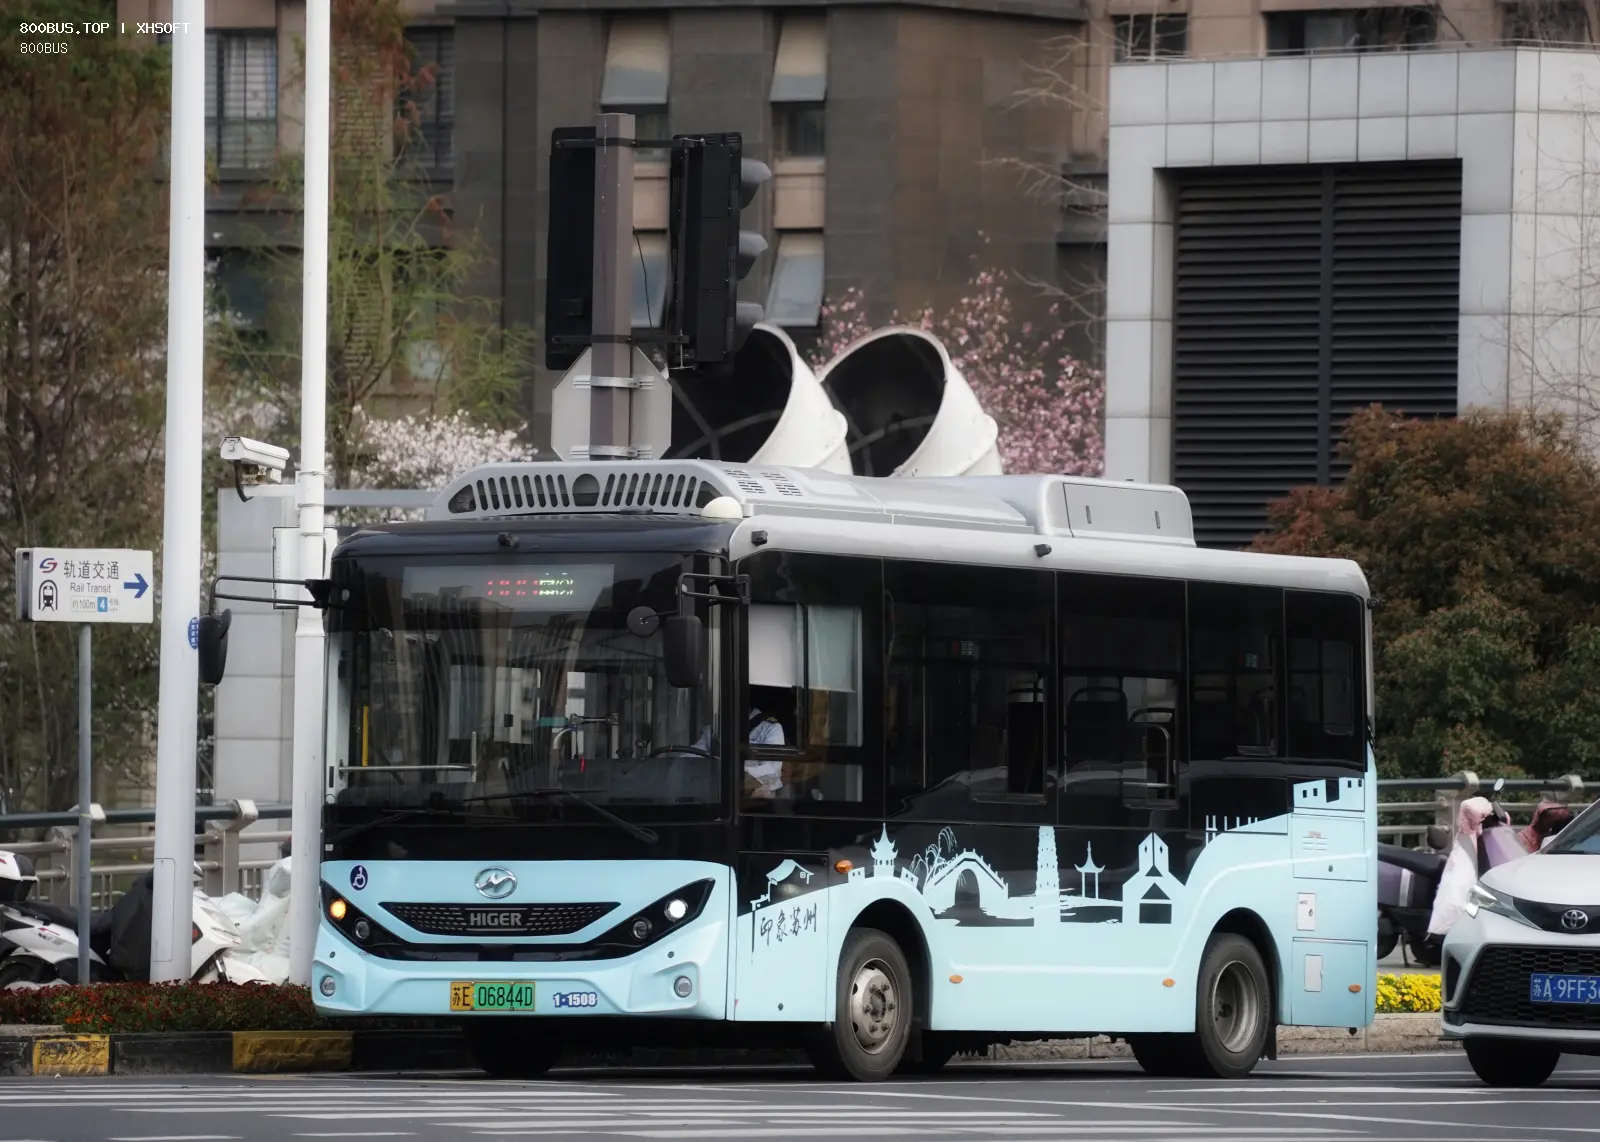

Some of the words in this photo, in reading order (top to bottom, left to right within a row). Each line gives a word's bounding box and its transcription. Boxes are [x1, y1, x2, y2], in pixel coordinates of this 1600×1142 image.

[63, 560, 119, 579] 轨道交通
[70, 582, 84, 593] Rail
[87, 582, 111, 593] Transit
[470, 912, 522, 926] HIGER
